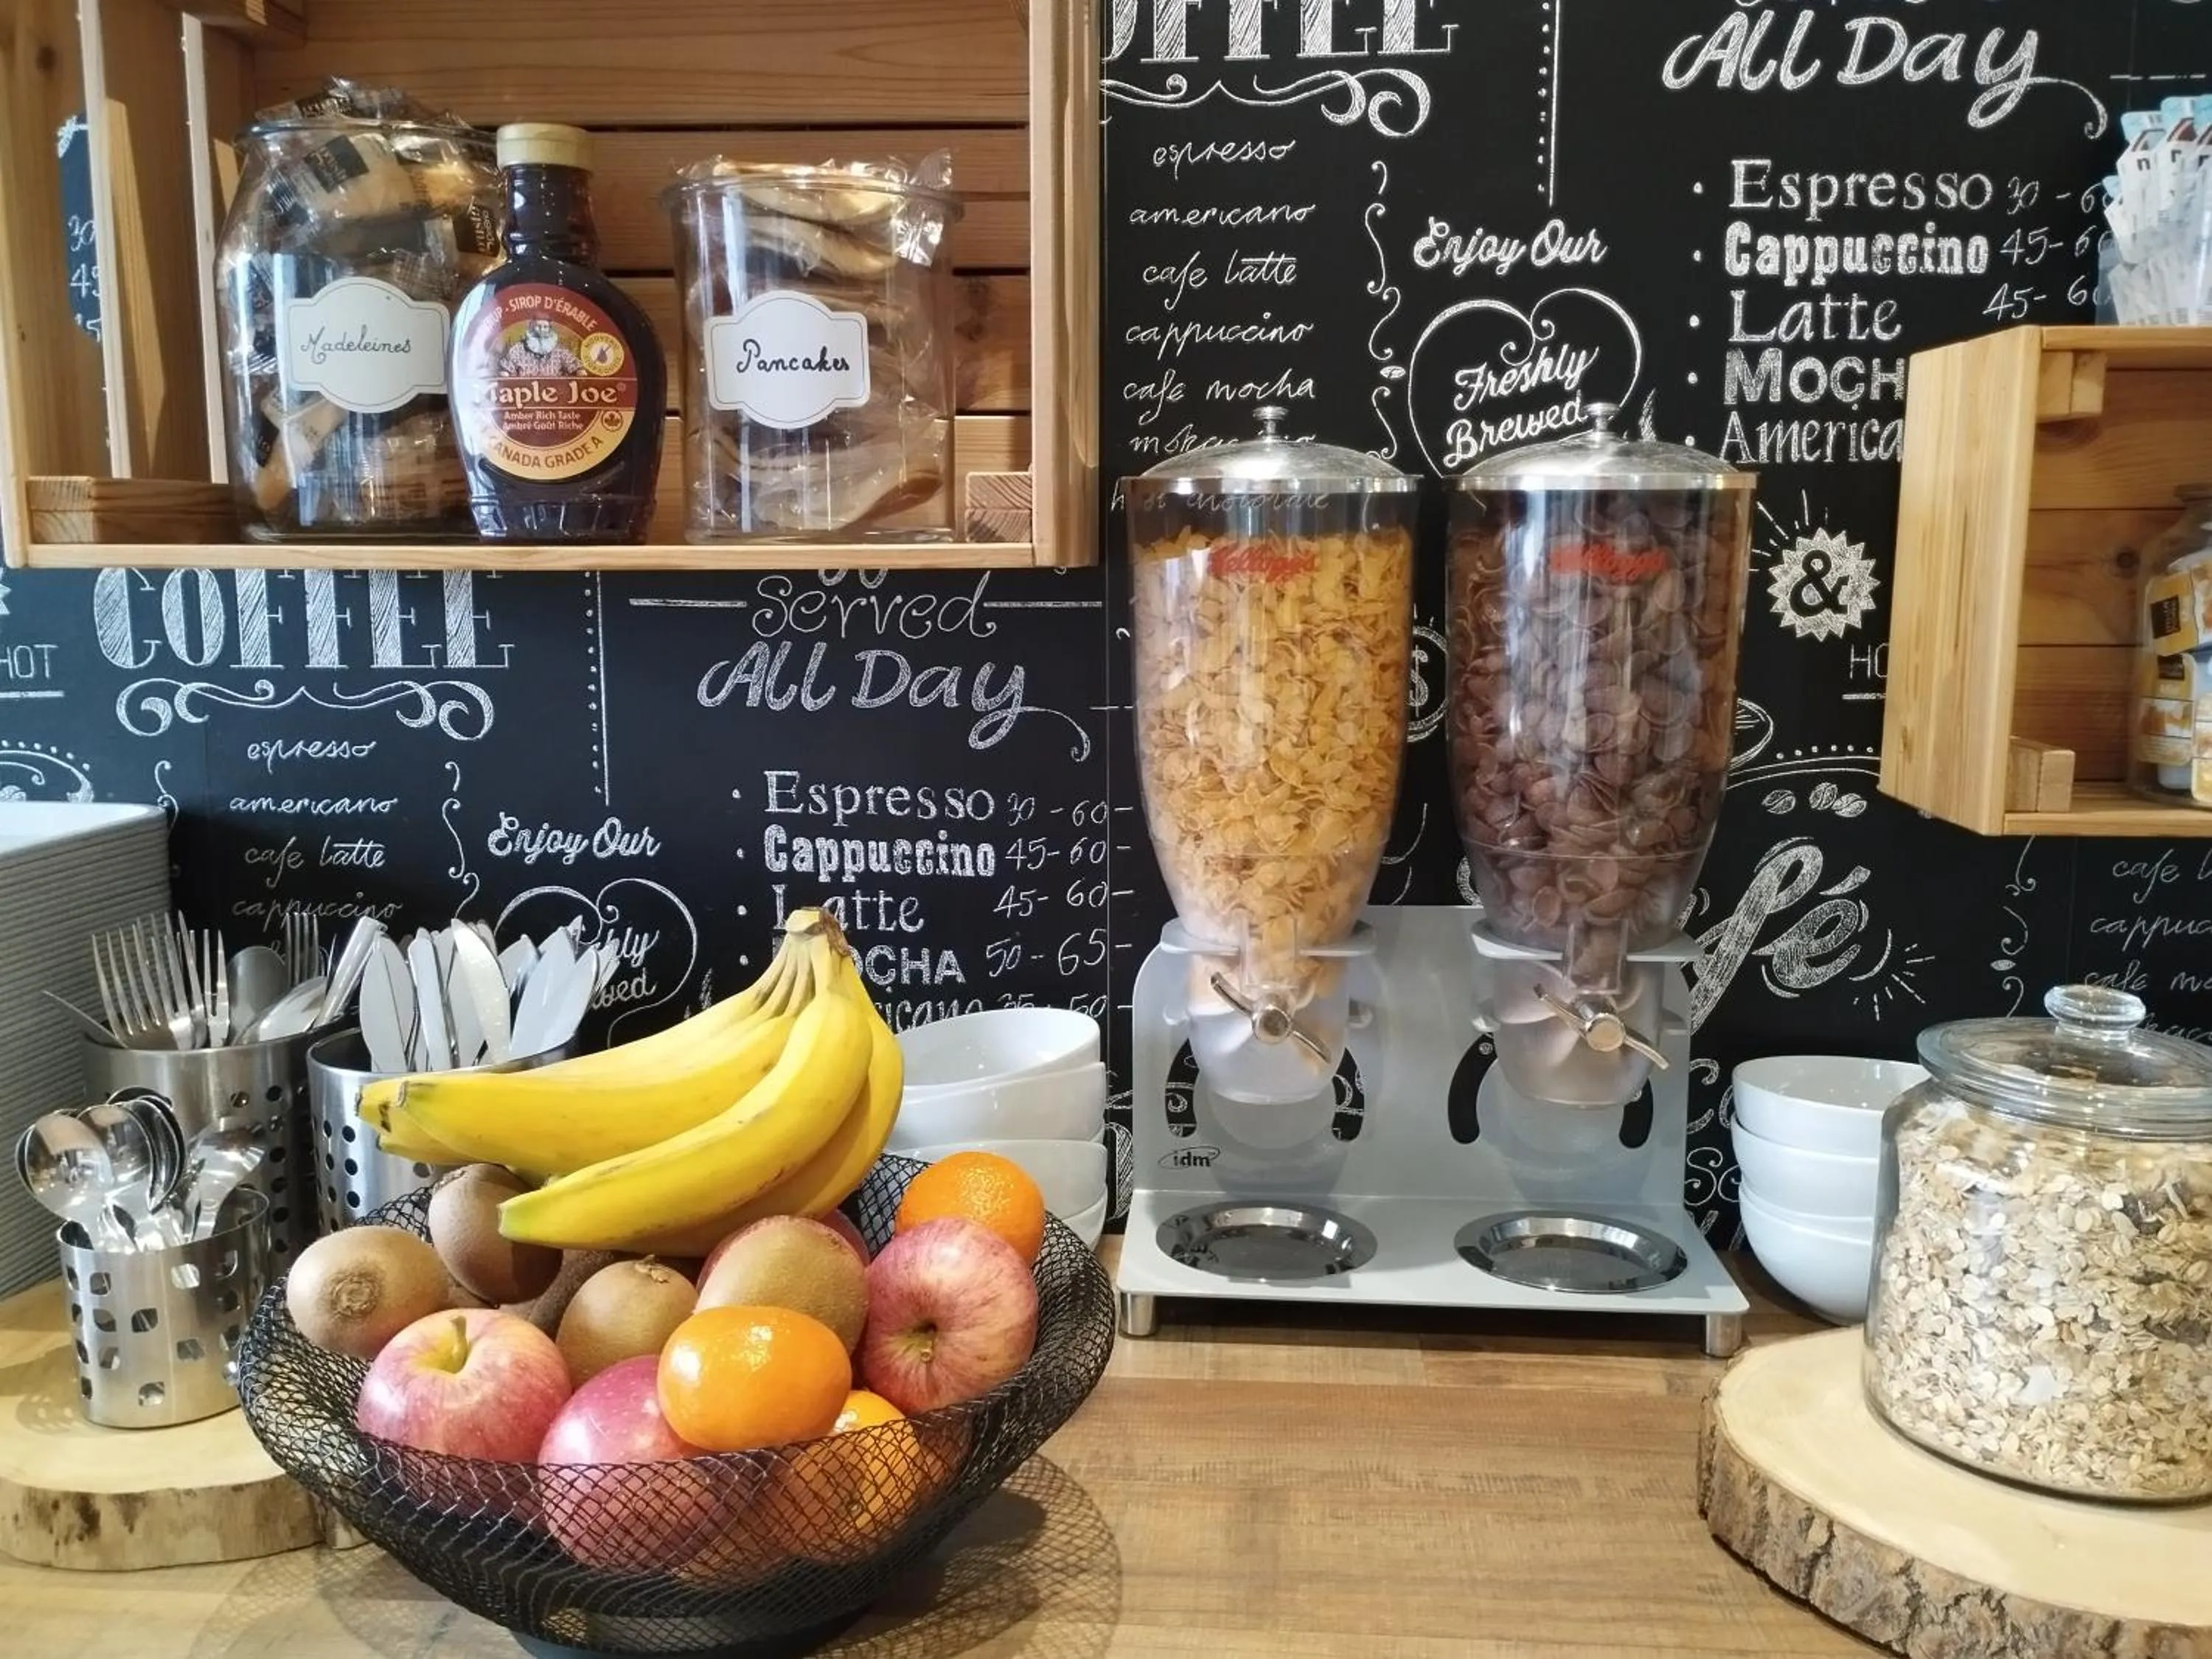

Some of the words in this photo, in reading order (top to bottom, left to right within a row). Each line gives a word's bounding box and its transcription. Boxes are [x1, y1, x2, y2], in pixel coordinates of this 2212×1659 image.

[1661, 9, 1821, 91] All
[1834, 15, 2110, 140] Day
[1152, 139, 1296, 181] espresso
[1129, 204, 1316, 226] americano
[1728, 158, 1994, 223] Espresso
[2006, 176, 2039, 215] 30
[1412, 215, 1527, 278] Enjoy
[1530, 218, 1608, 268] Our
[1724, 222, 1989, 287] Cappuccino
[1142, 250, 1208, 311] cafe
[1224, 253, 1297, 285] latte
[509, 294, 542, 312] SIROP
[543, 295, 599, 331] D'ÉRABLE
[1125, 311, 1315, 361] cappuccino
[1728, 288, 1902, 343] Latte
[300, 329, 411, 364] Madeleines
[737, 338, 850, 373] Pancakes
[566, 380, 618, 404] Joe
[1123, 368, 1186, 426] cafe
[1206, 368, 1316, 402] mocha
[1454, 345, 1599, 411] Freshly
[1723, 347, 1905, 405] MOCH
[536, 411, 556, 420] Rich
[1443, 389, 1587, 466] Brewed
[1719, 403, 1904, 464] America
[544, 444, 591, 469] GRADE
[590, 435, 604, 451] A
[752, 571, 997, 639] Served
[1849, 643, 1889, 680] HO
[697, 641, 836, 712] All
[848, 647, 1091, 762] Day
[247, 739, 377, 774] espresso
[229, 797, 398, 815] americano
[763, 770, 995, 830] Espresso
[1006, 793, 1035, 827] 30
[242, 833, 305, 889] cafe
[317, 833, 388, 870] latte
[487, 811, 589, 866] Enjoy
[592, 816, 661, 859] Our
[763, 824, 996, 883] Cappuccino
[2112, 848, 2181, 905] cafe
[985, 938, 1021, 978] 50
[1057, 926, 1106, 978] 65
[2090, 914, 2212, 953] cappuc
